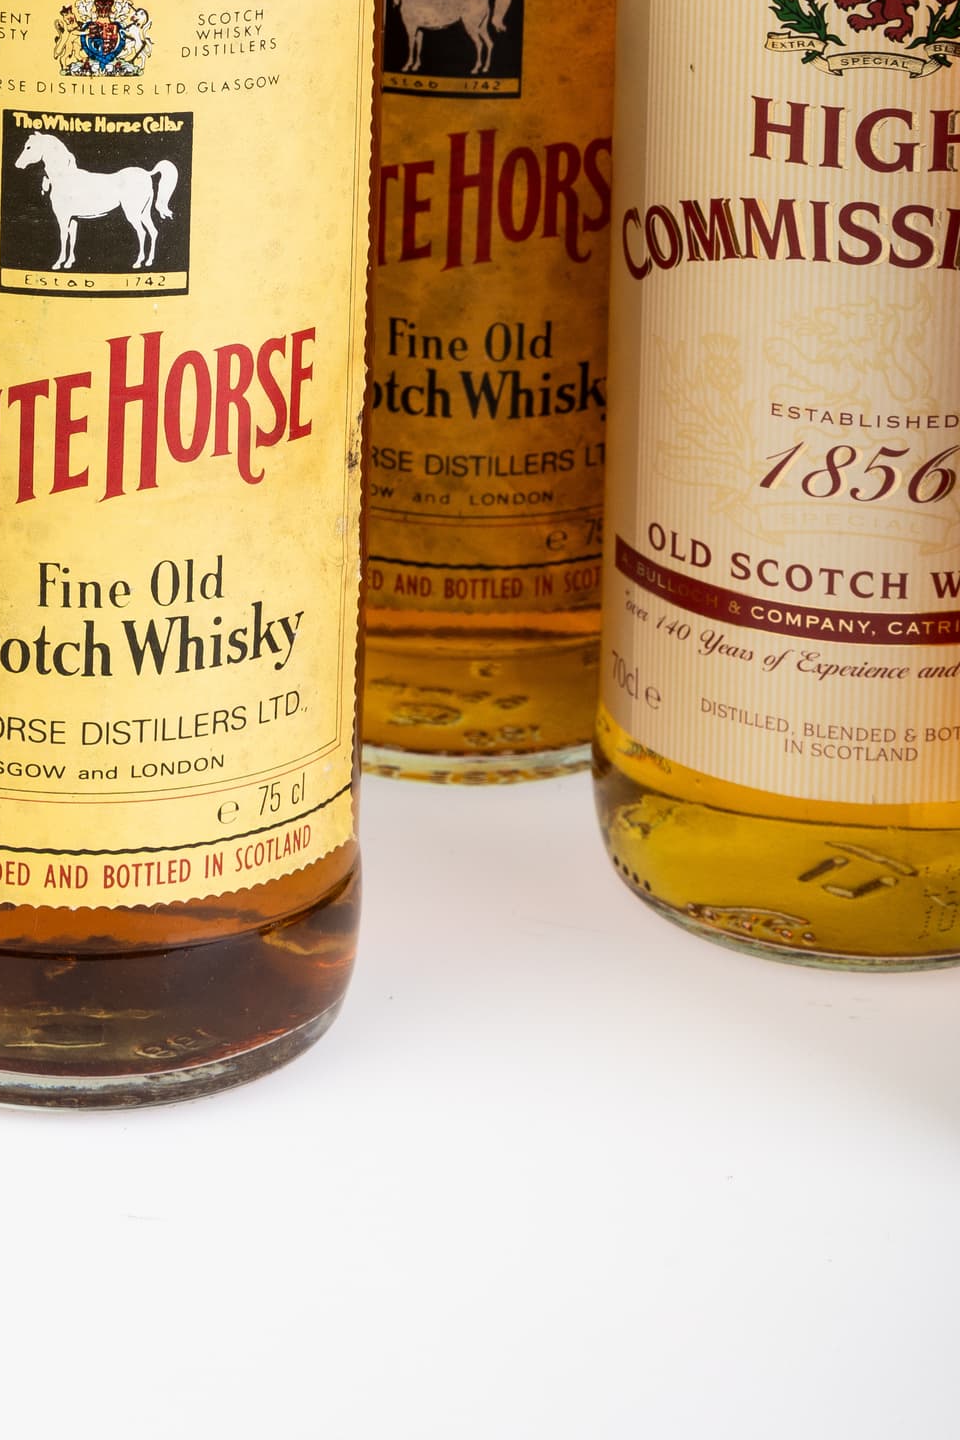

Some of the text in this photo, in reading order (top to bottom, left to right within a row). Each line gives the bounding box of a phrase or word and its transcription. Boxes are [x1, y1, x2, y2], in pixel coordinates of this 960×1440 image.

[195, 24, 263, 40] WHISKY
[197, 8, 265, 27] SCOTCH
[181, 37, 278, 58] DISTILLERS
[770, 39, 817, 51] EXTRA
[839, 56, 911, 70] SPECIAL
[36, 80, 145, 96] DISTILLERS
[197, 73, 281, 94] GLASGOW
[463, 78, 502, 91] 1742
[13, 112, 43, 130] The
[42, 113, 92, 133] White
[94, 115, 142, 134] Horse
[24, 274, 168, 289] Estab 1742
[387, 316, 553, 362] Fine Old
[459, 361, 607, 422] Whisk
[96, 326, 317, 503] HORSE
[770, 402, 960, 430] ESTABLISHED
[424, 448, 575, 478] DISTILLERS
[759, 440, 960, 504] 1856
[411, 490, 451, 505] and
[469, 489, 555, 506] LONDON
[647, 521, 713, 568] OLD
[729, 551, 909, 600] SCOTCH
[36, 554, 225, 610] Fine Old
[393, 571, 433, 599] AND
[443, 576, 524, 601] BOTTLED
[534, 572, 554, 597] IN
[750, 605, 878, 637] COMPANY,
[121, 600, 305, 676] Whisky
[655, 614, 960, 681] 140 Years of Experience and
[81, 705, 248, 746] DISTILLERS
[803, 722, 897, 743] BLENDED
[903, 727, 917, 743] &
[783, 738, 919, 763] IN SCOTLAND
[77, 765, 119, 781] and
[130, 753, 225, 779] LONDON
[258, 780, 281, 816] 75
[290, 771, 306, 805] cl
[43, 863, 89, 890] AND
[102, 858, 192, 889] BOTTLED
[203, 851, 224, 879] IN
[234, 823, 312, 873] SCOTLAND
